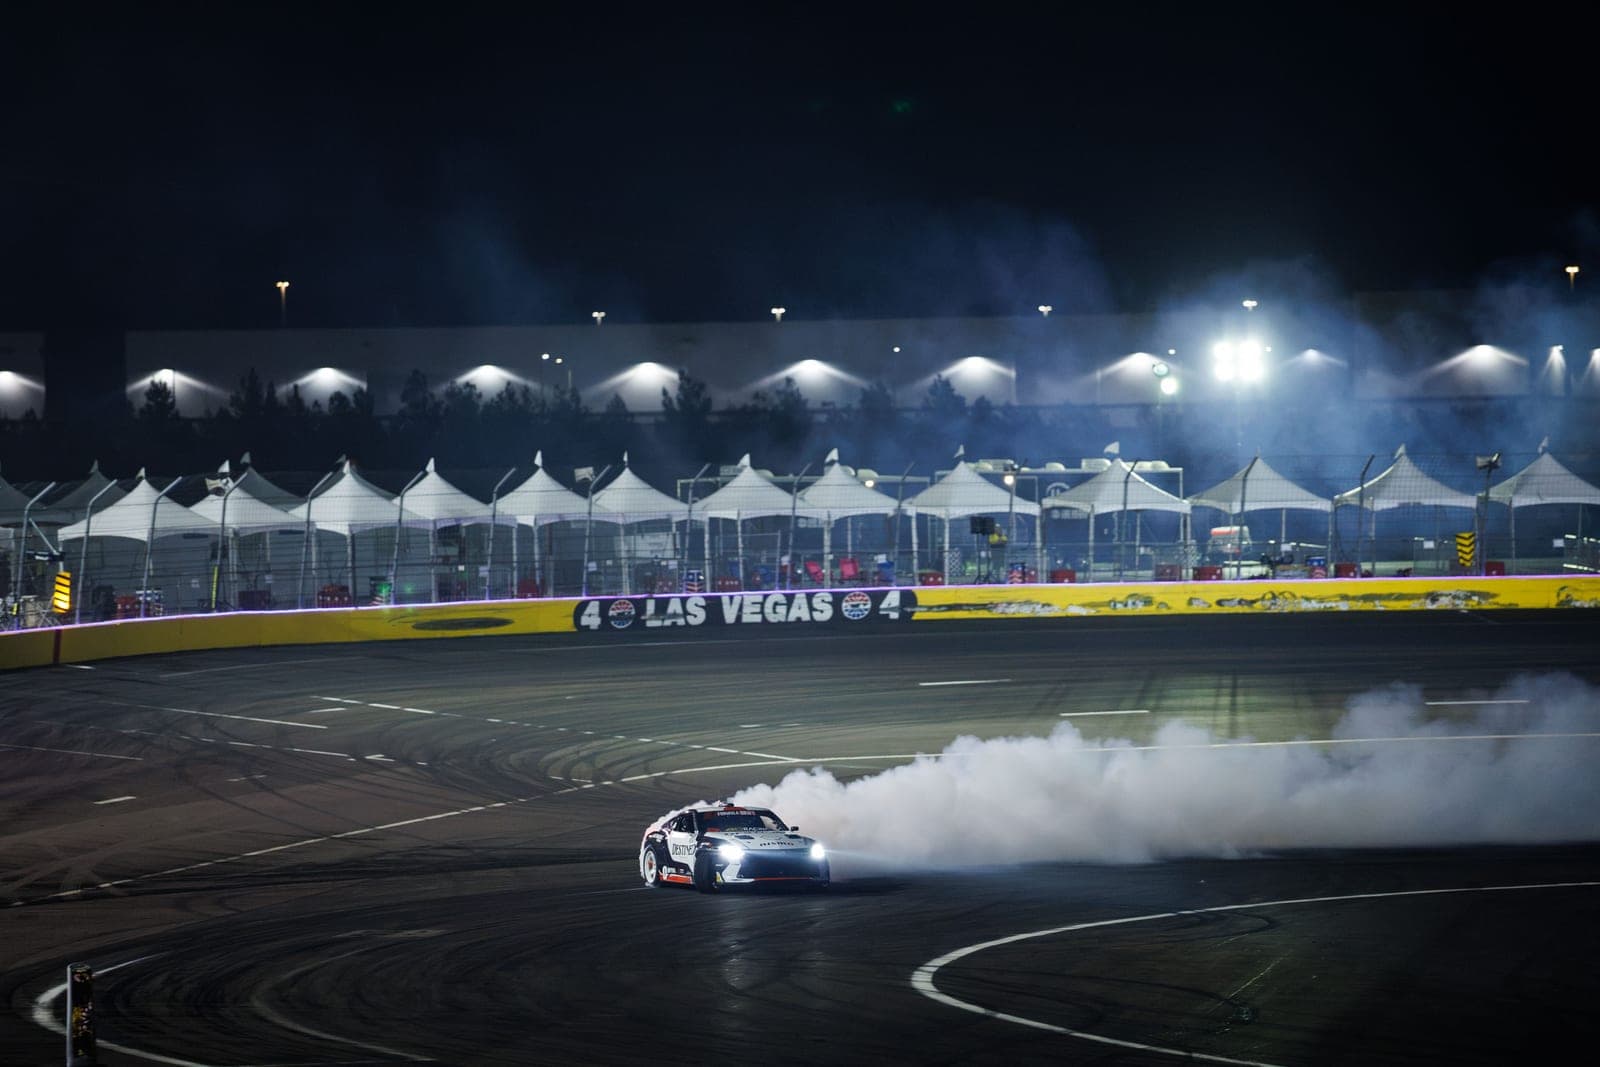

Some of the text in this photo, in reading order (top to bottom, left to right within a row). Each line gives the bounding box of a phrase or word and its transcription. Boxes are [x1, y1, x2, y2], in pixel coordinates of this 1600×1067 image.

[580, 590, 901, 630] 4 LAS VEGAS 4
